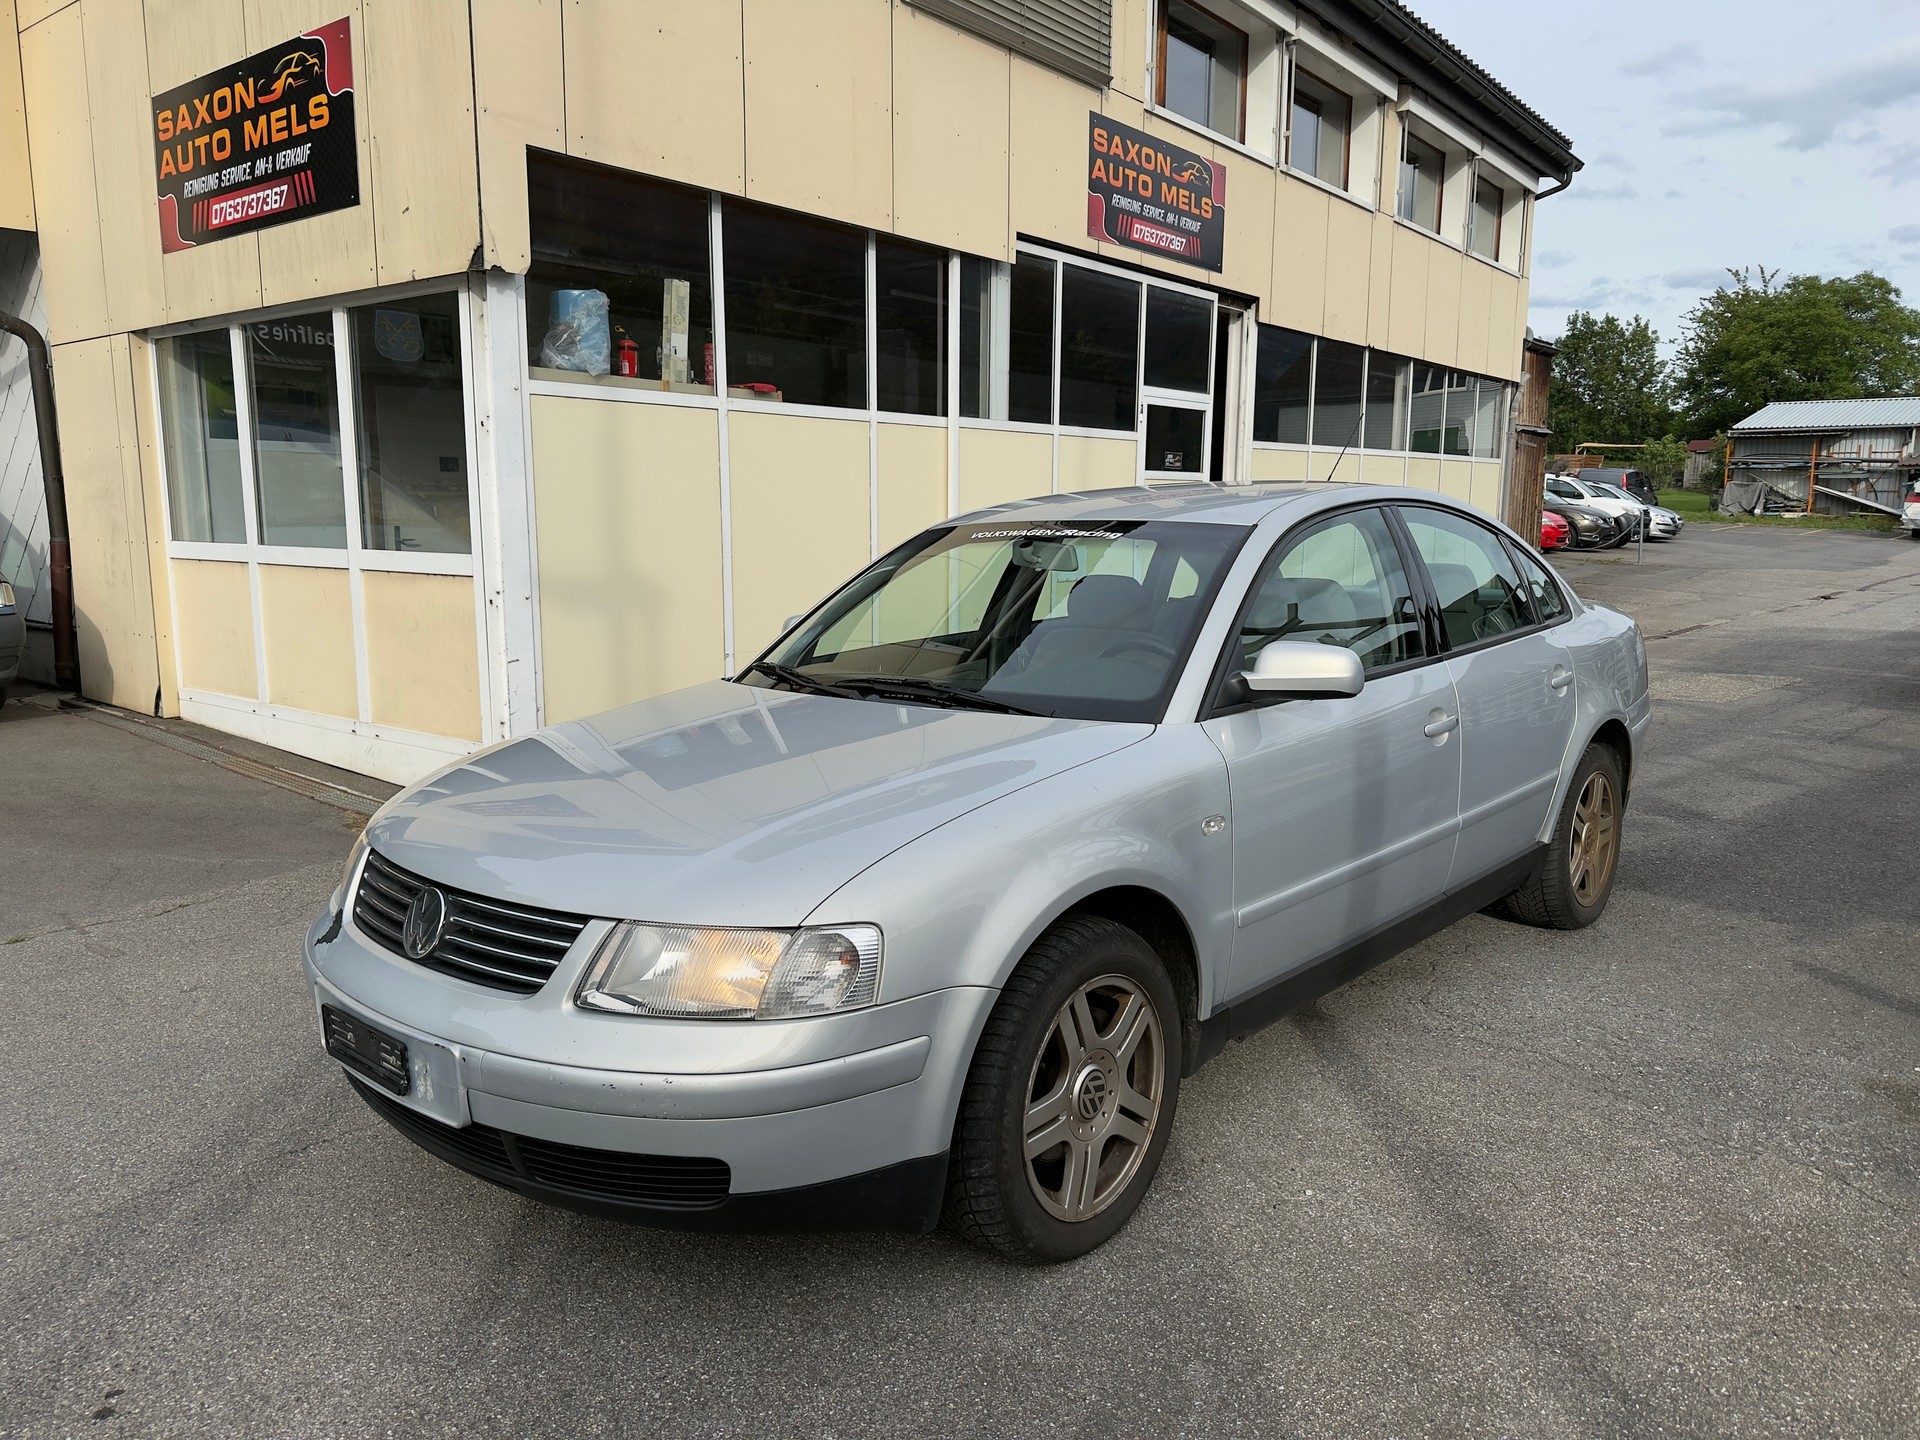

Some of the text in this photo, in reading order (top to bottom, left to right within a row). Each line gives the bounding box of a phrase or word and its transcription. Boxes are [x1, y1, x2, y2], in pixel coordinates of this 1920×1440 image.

[157, 77, 255, 142] SAXON
[160, 94, 330, 180] AUTO MELS
[1093, 127, 1171, 177] SAXON
[184, 172, 219, 199] REINIGUNG
[221, 161, 252, 188] SERVICE,
[275, 142, 312, 171] VERKAUF
[1091, 158, 1213, 219] AUTO MELS
[212, 184, 288, 225] 0763737367
[1179, 215, 1202, 234] VERKAUF
[1133, 223, 1187, 252] 0763737367
[970, 529, 1124, 540] VOLKSWAGEN Racing
